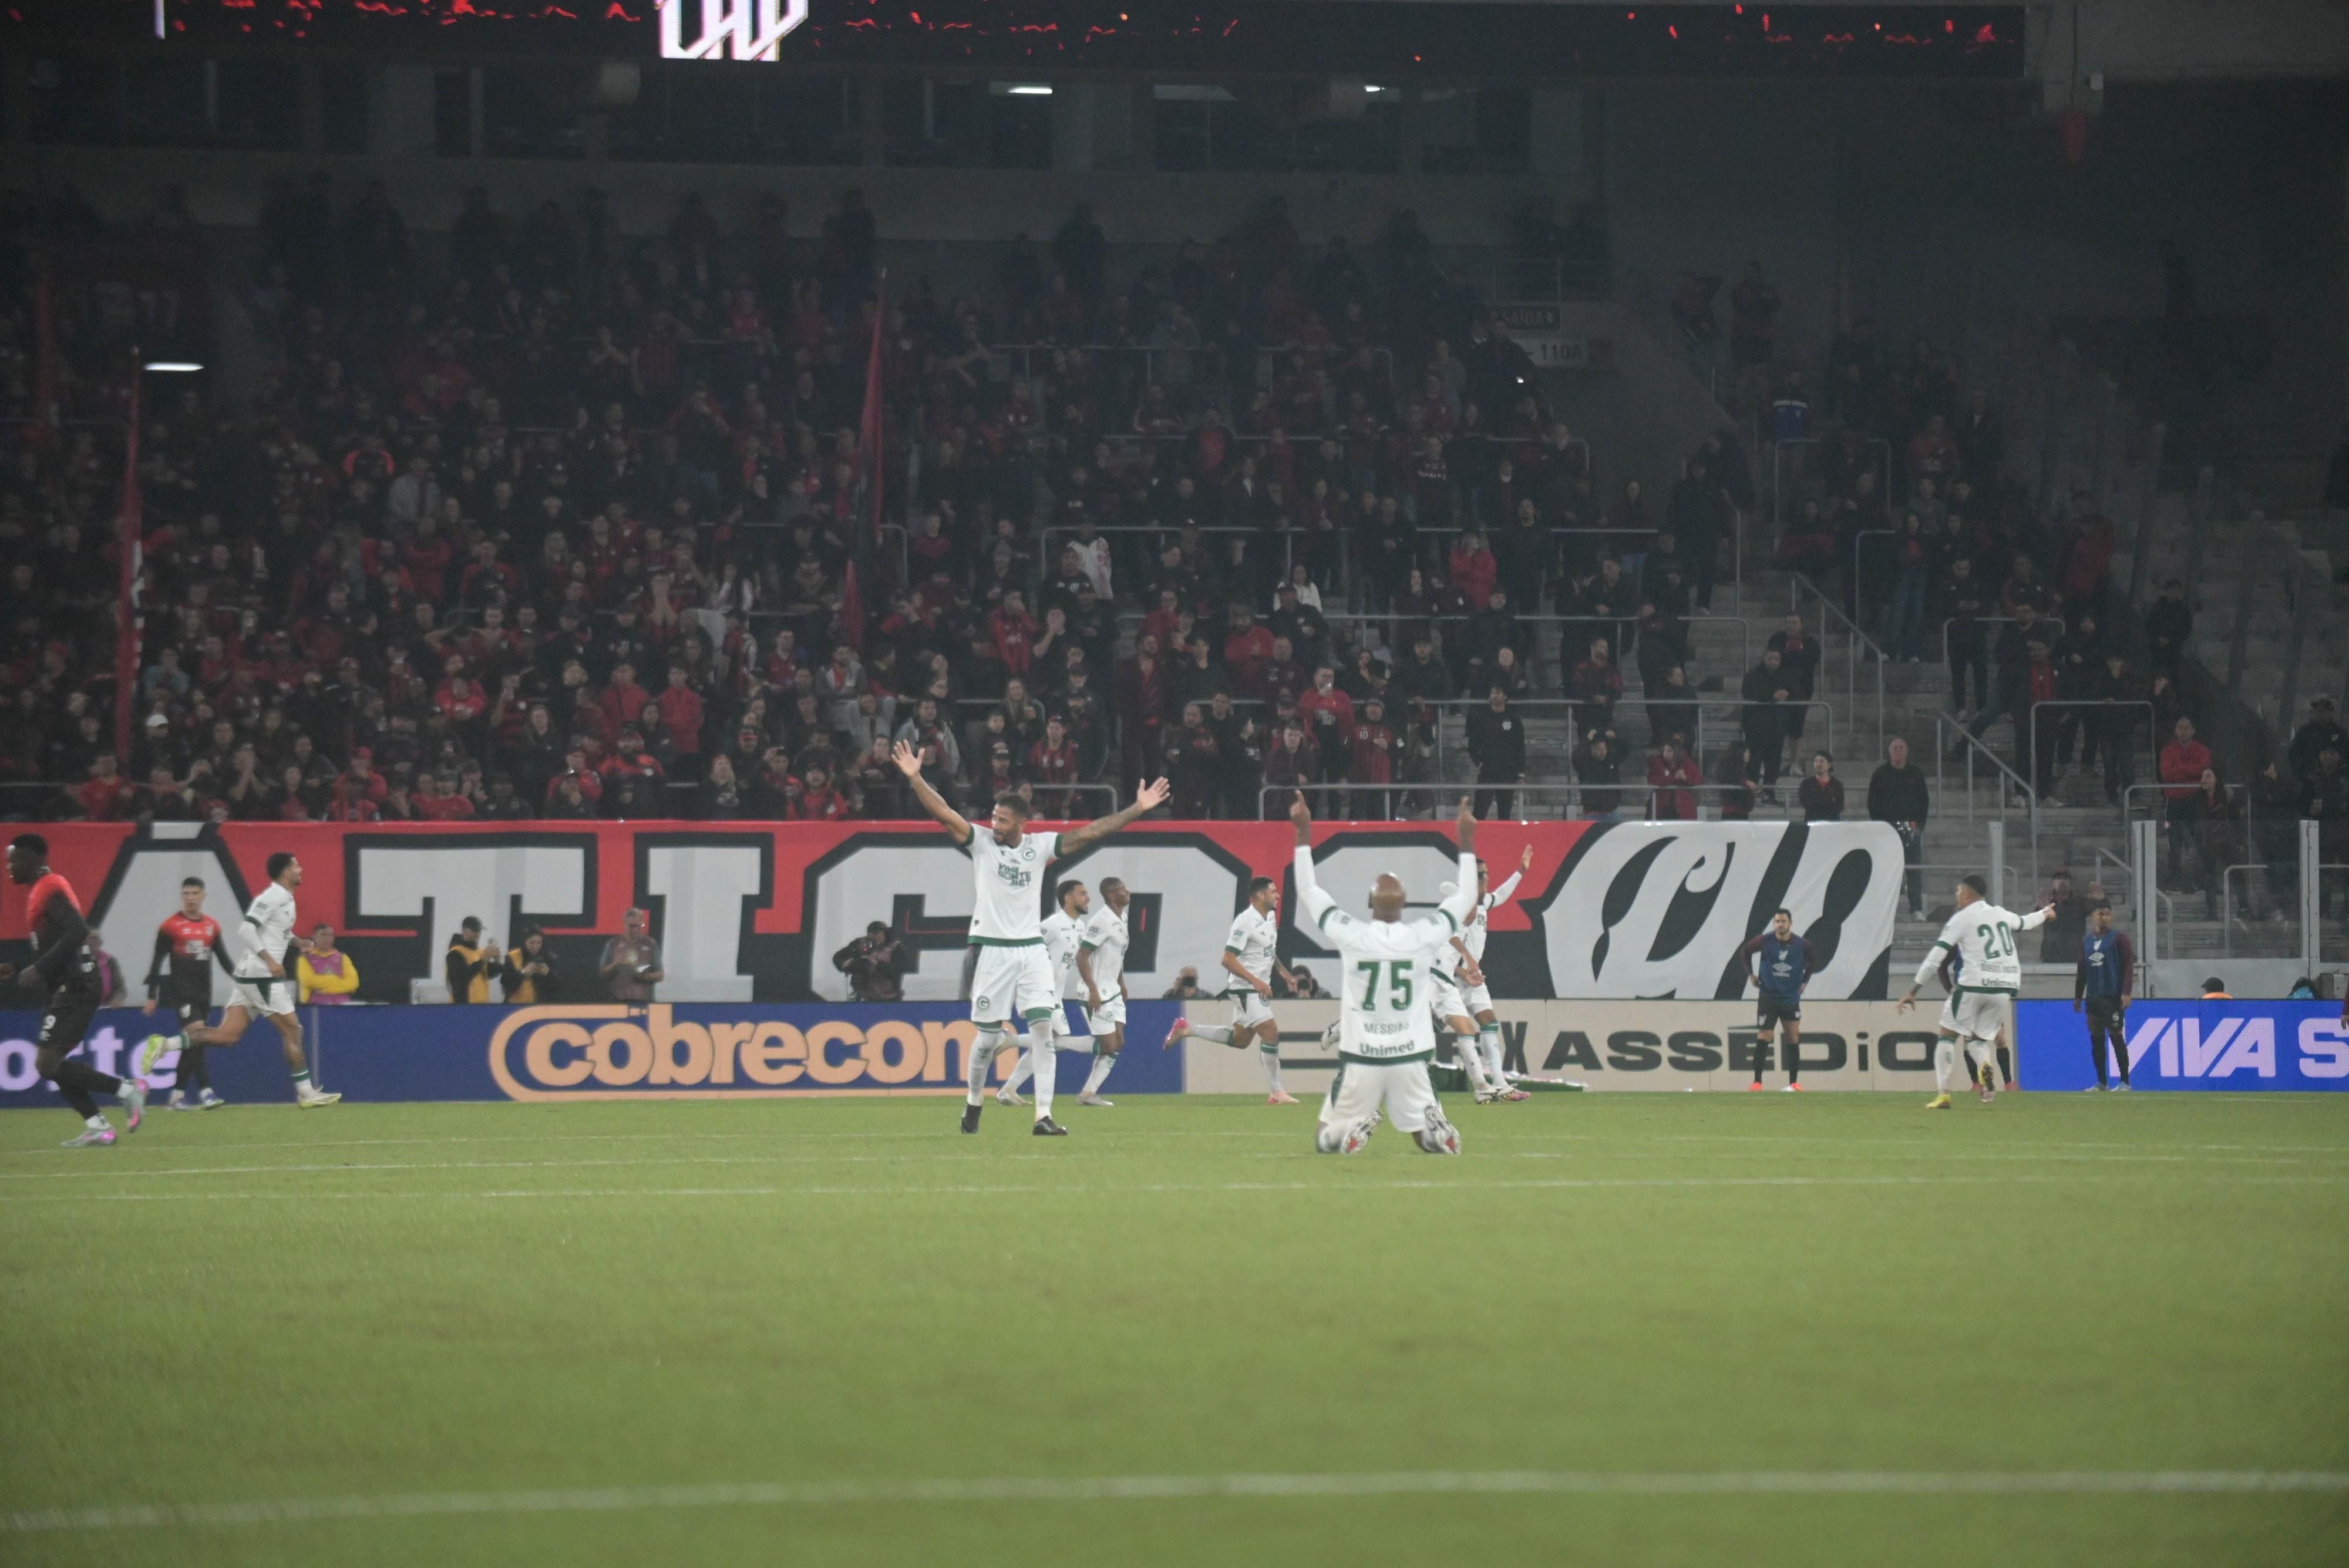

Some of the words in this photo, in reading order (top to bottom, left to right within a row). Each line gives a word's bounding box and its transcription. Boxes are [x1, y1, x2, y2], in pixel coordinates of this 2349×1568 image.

[1977, 921, 2013, 960] 20
[1357, 960, 1413, 1011] 75
[43, 1014, 56, 1029] 9
[1364, 1021, 1409, 1035] MESSIAS
[1359, 1040, 1415, 1055] Unimed
[2107, 1018, 2276, 1078] VIVA
